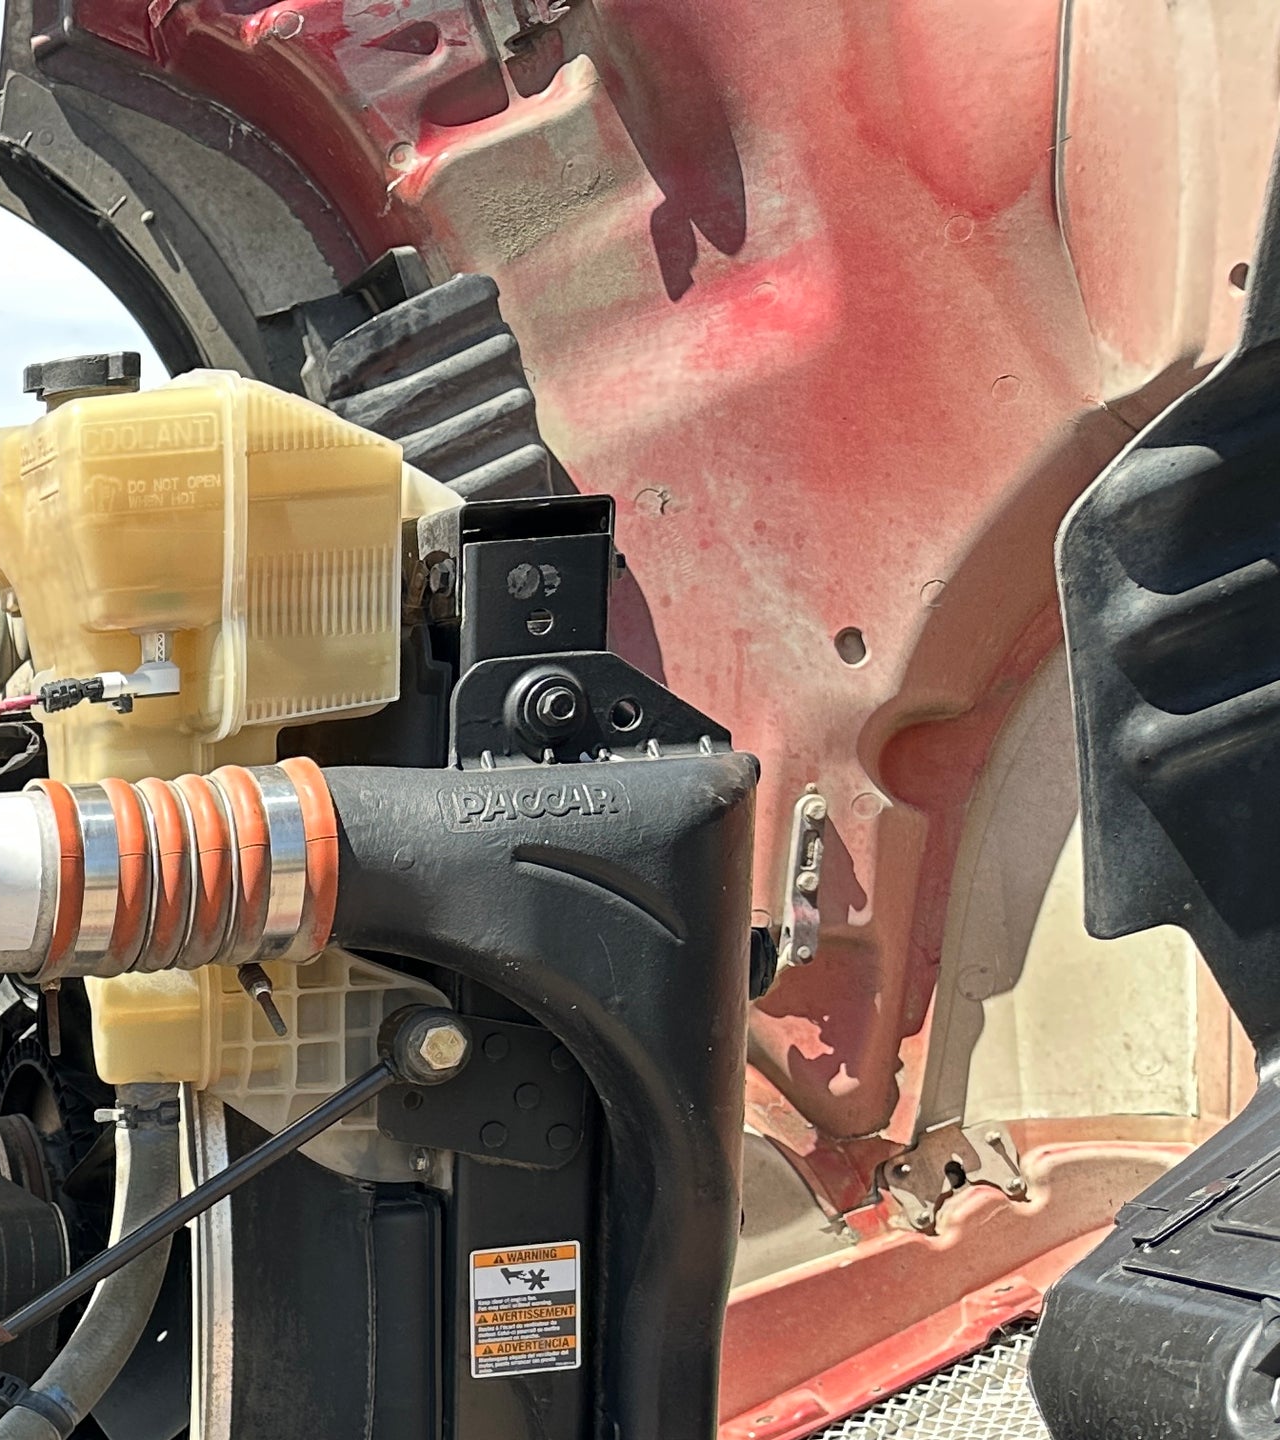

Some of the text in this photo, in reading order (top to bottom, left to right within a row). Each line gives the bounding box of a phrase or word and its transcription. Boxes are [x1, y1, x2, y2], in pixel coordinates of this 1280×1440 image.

[82, 418, 210, 453] COOLANT
[127, 474, 222, 493] DO NOT OPEN
[127, 490, 197, 509] WHEN HOT
[452, 783, 620, 824] PACCAR
[506, 1248, 558, 1263] WARNING
[491, 1305, 574, 1323] AVERTISSEMENT
[496, 1337, 570, 1354] ADVERTENCIA
